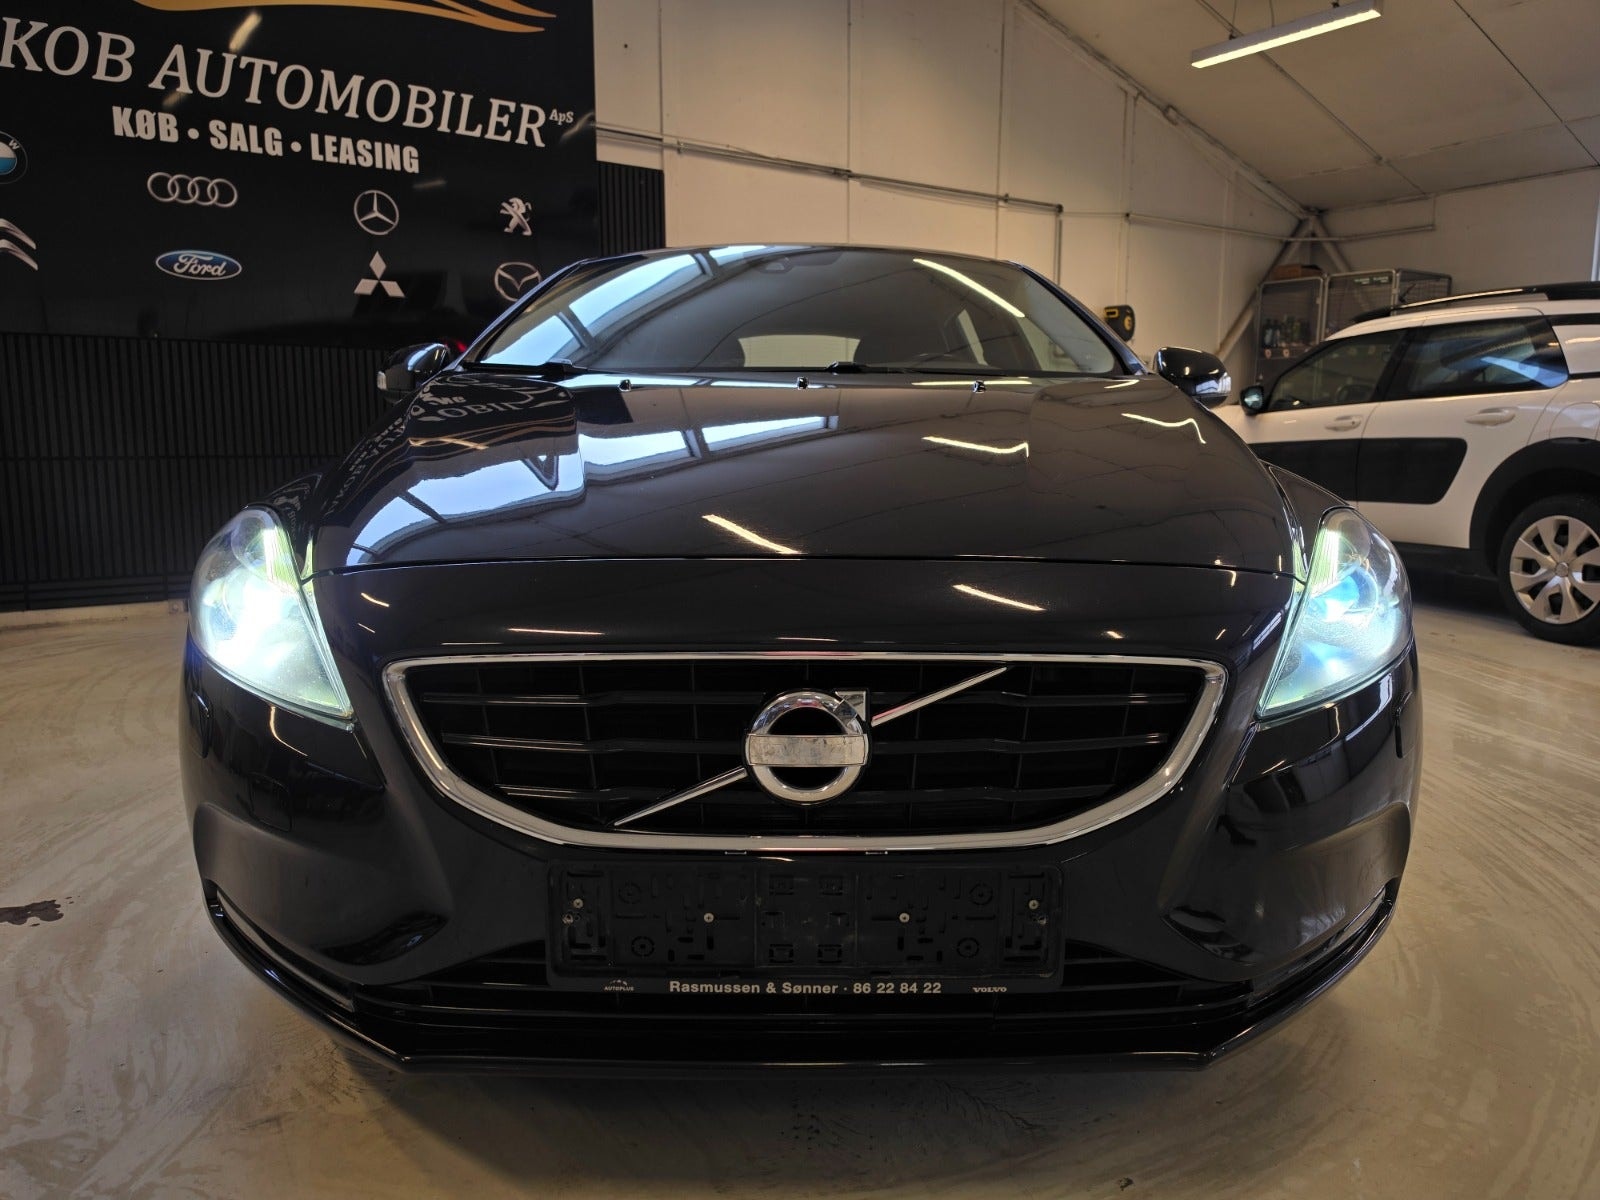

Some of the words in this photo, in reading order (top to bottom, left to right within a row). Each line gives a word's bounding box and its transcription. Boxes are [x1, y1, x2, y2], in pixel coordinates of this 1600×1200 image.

[148, 44, 546, 148] AUTOMOBILER
[549, 108, 574, 125] ApS
[112, 106, 179, 143] KØB
[209, 120, 283, 156] SALG
[310, 133, 419, 173] LEASING
[173, 253, 227, 276] Ford
[669, 980, 761, 993] Rasmussen
[766, 981, 777, 993] &
[782, 981, 839, 994] Sønner
[853, 982, 872, 994] 86
[876, 982, 895, 994] 22
[899, 982, 918, 994] 84
[923, 982, 942, 994] 22
